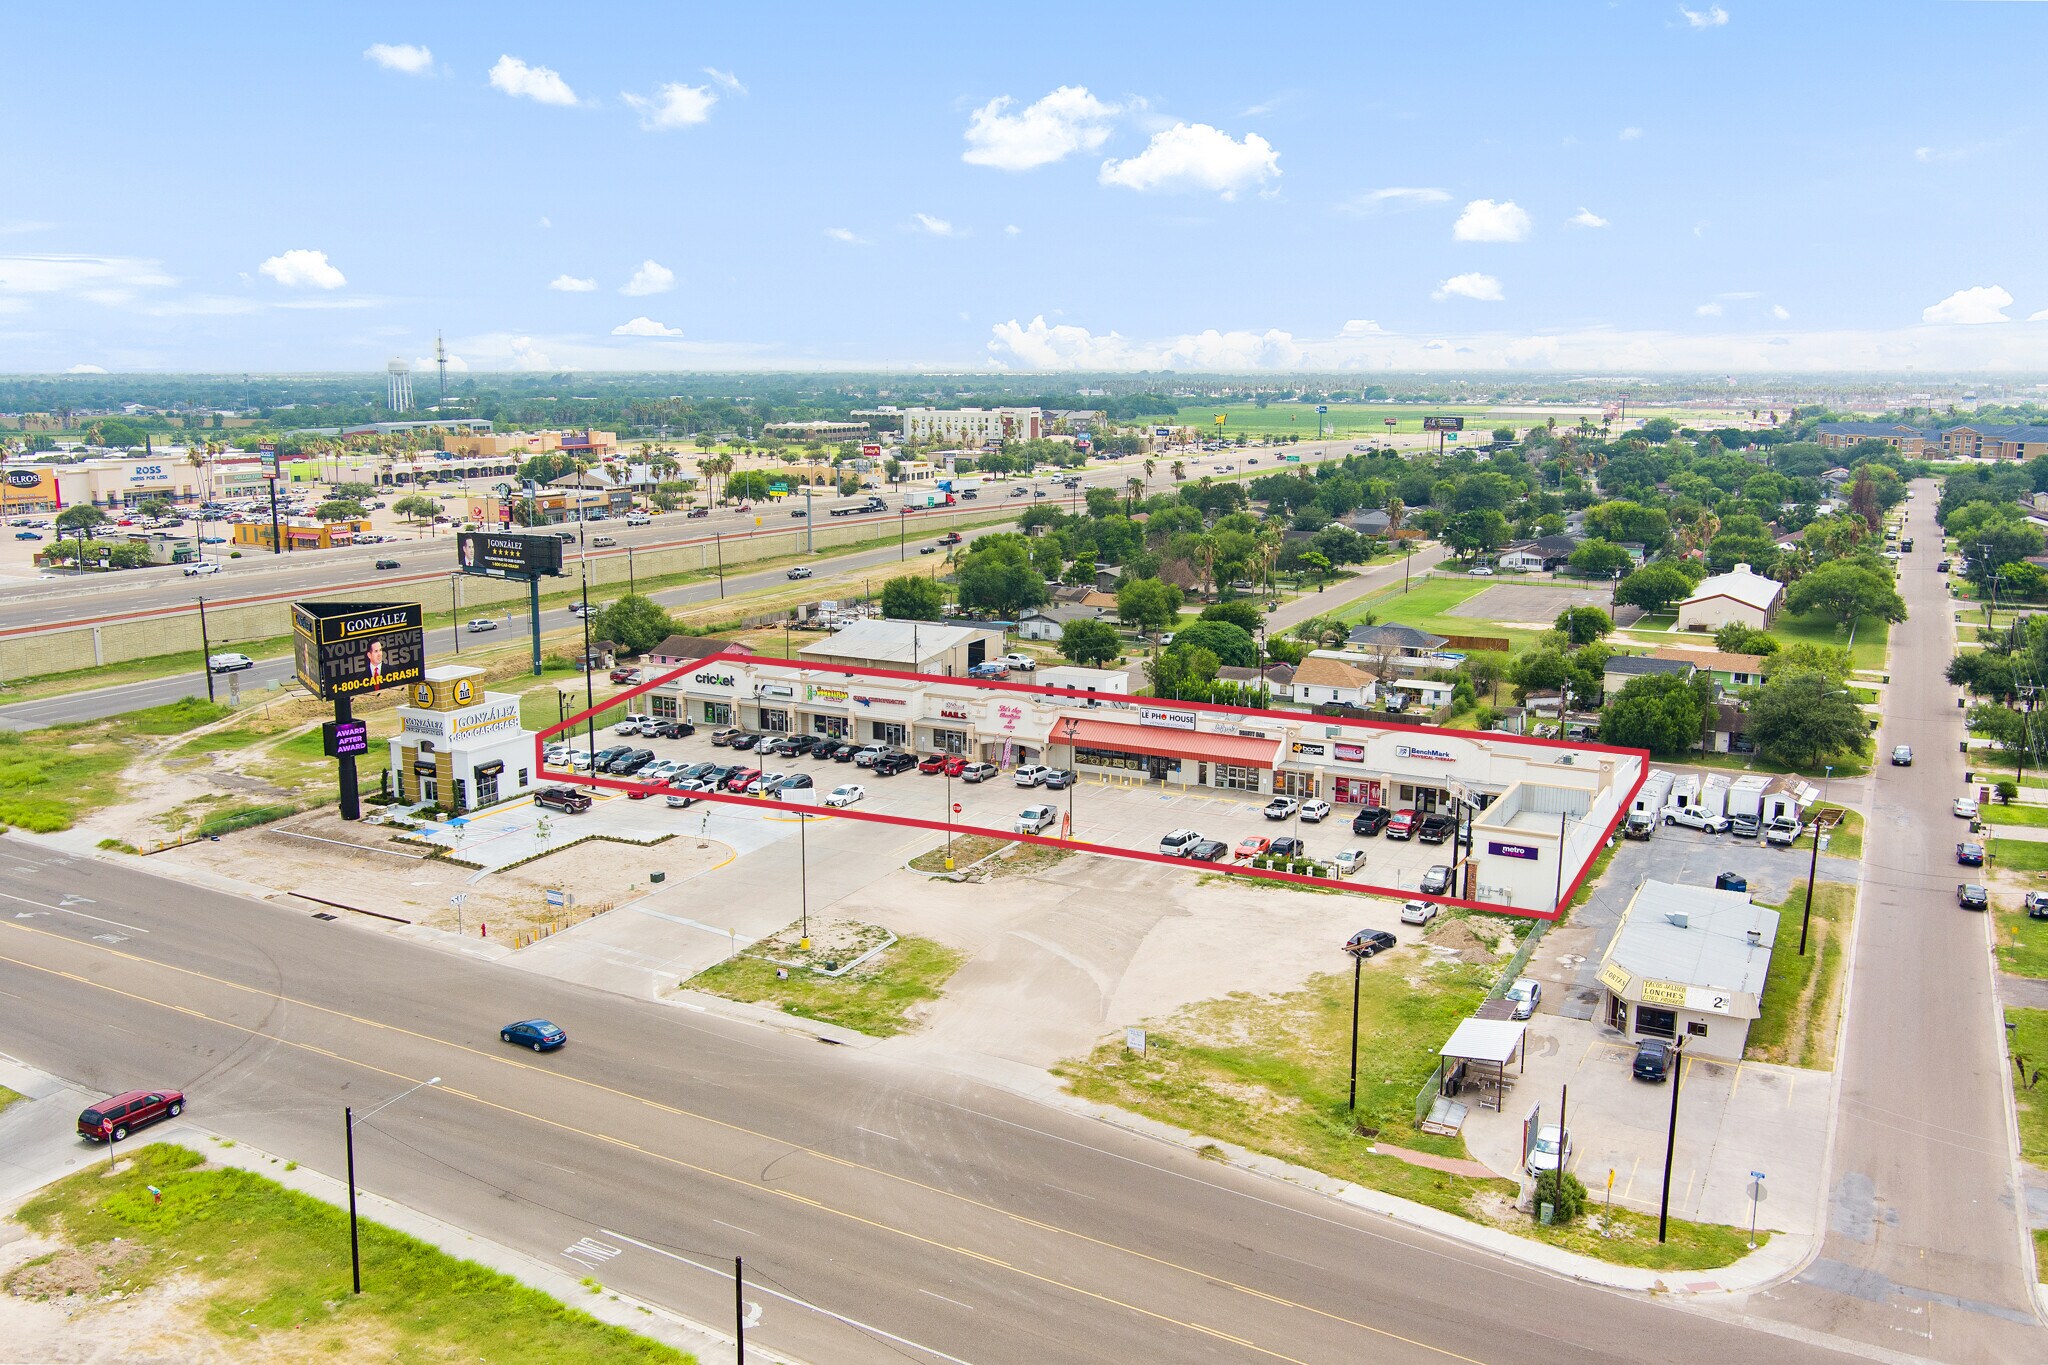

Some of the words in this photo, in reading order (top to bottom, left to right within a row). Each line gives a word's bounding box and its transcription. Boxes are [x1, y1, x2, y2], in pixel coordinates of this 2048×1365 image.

[136, 466, 161, 474] ROSS
[347, 612, 407, 632] GONZÁLEZ
[325, 642, 356, 658] YOU
[370, 631, 420, 650] DSERVE
[326, 656, 366, 678] THE
[332, 668, 419, 693] 1-800-CAR-CRASH
[695, 673, 734, 686] cricket
[458, 706, 516, 727] GONZÁLEZ
[941, 710, 967, 719] NAILS
[1170, 714, 1194, 723] HOUSE
[336, 728, 365, 737] AWARD
[339, 736, 362, 745] AFTER
[338, 743, 366, 752] AWARD
[1412, 748, 1449, 757] BenchMark
[1605, 970, 1626, 987] TORTAS
[1644, 988, 1684, 999] LONCHES
[560, 1237, 622, 1270] ONLY
